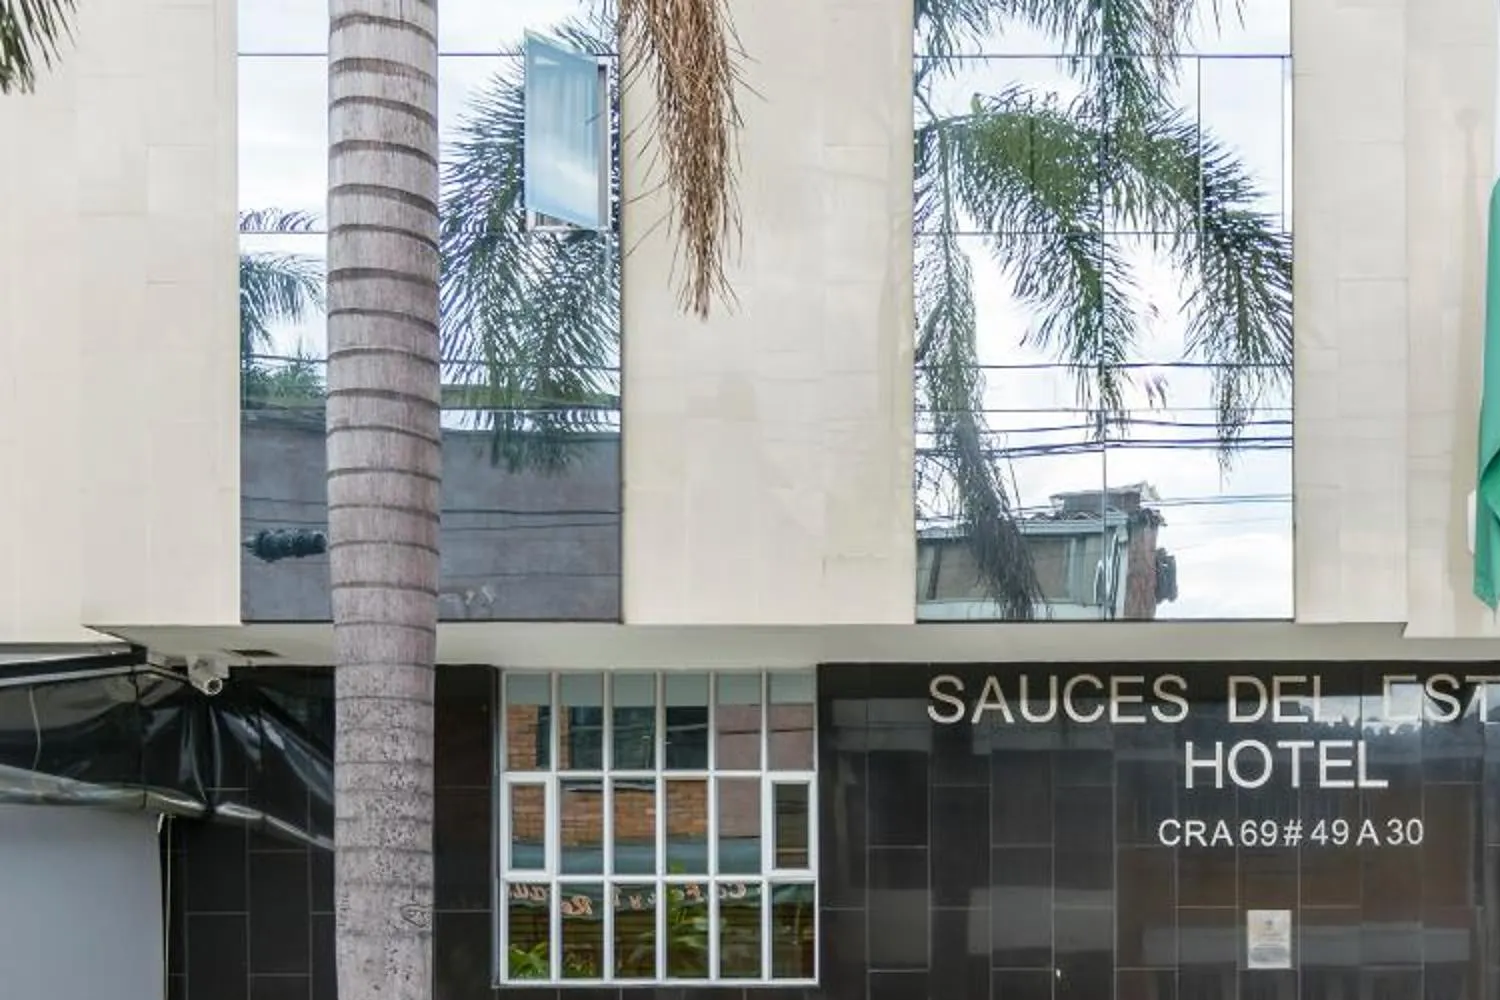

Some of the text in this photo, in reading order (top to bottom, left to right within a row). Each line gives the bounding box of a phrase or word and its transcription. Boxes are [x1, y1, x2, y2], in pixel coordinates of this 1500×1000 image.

[927, 675, 1189, 724] SAUCES
[1227, 676, 1347, 724] DEL
[1185, 739, 1390, 789] HOTEL
[1158, 818, 1235, 847] CRA
[1309, 818, 1351, 847] 49
[1355, 818, 1381, 847] A
[1386, 817, 1424, 846] 30
